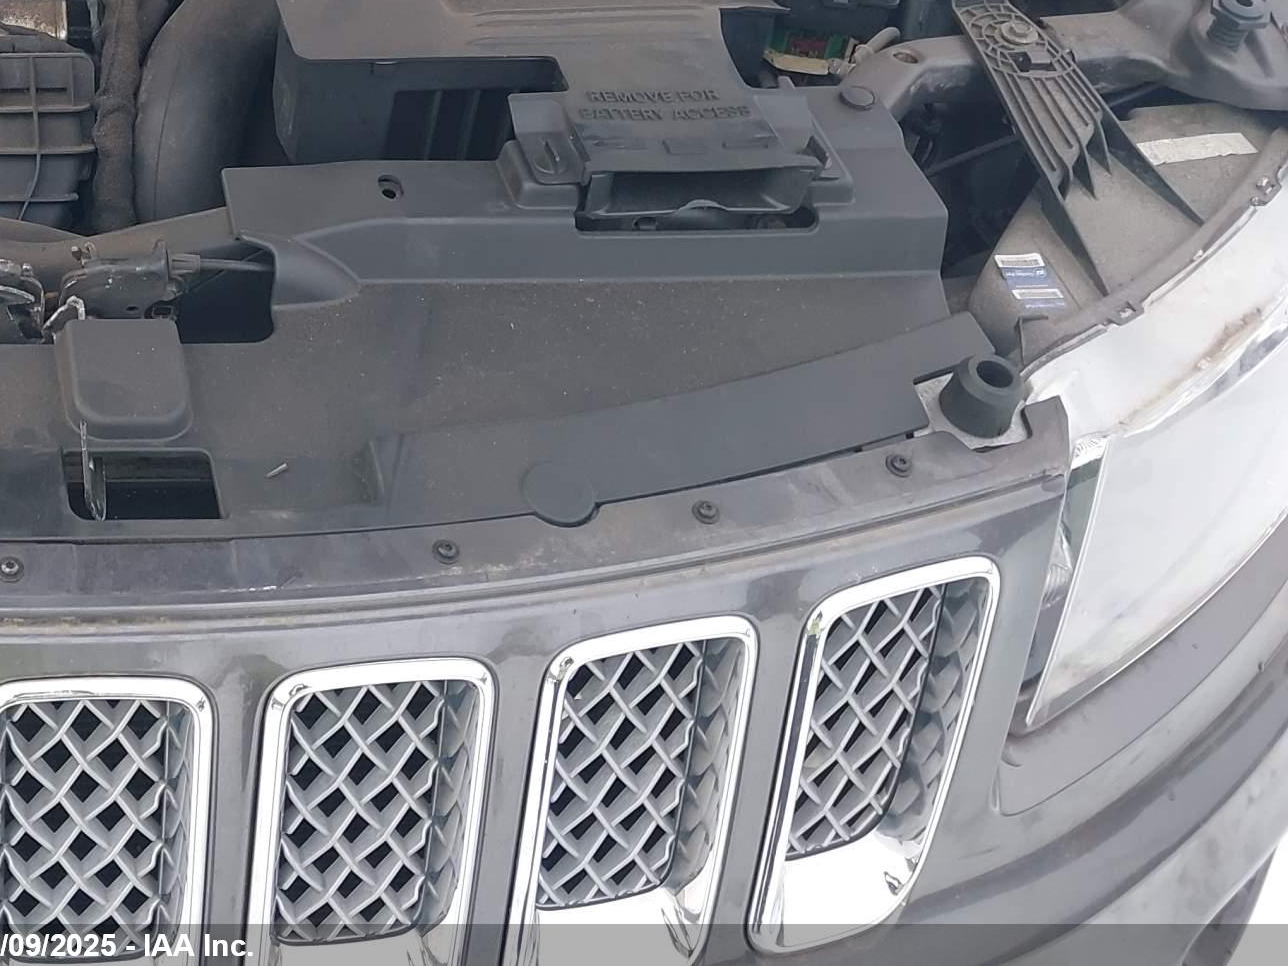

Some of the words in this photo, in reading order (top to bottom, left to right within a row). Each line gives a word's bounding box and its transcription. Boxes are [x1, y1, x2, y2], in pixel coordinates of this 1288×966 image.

[585, 89, 672, 104] REMOVE
[674, 89, 720, 102] FOR
[578, 107, 663, 122] BATTERY
[672, 105, 752, 121] ACCESS
